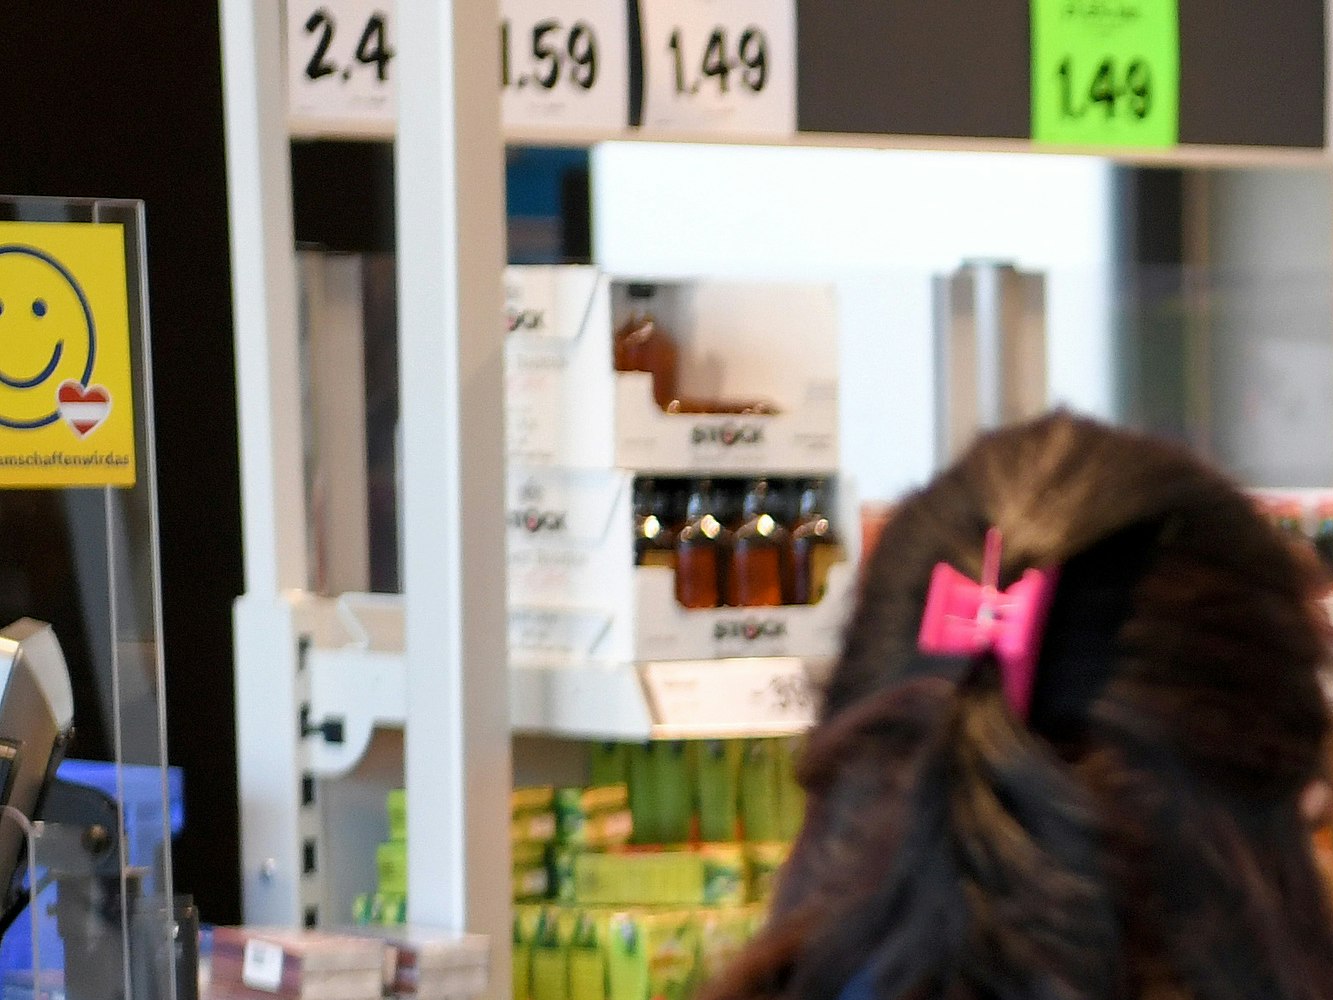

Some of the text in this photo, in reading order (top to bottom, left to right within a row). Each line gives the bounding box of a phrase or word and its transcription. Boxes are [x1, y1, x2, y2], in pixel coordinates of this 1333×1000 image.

[303, 8, 396, 83] 2.4
[667, 25, 769, 95] 1.49
[1055, 55, 1154, 123] 1.49
